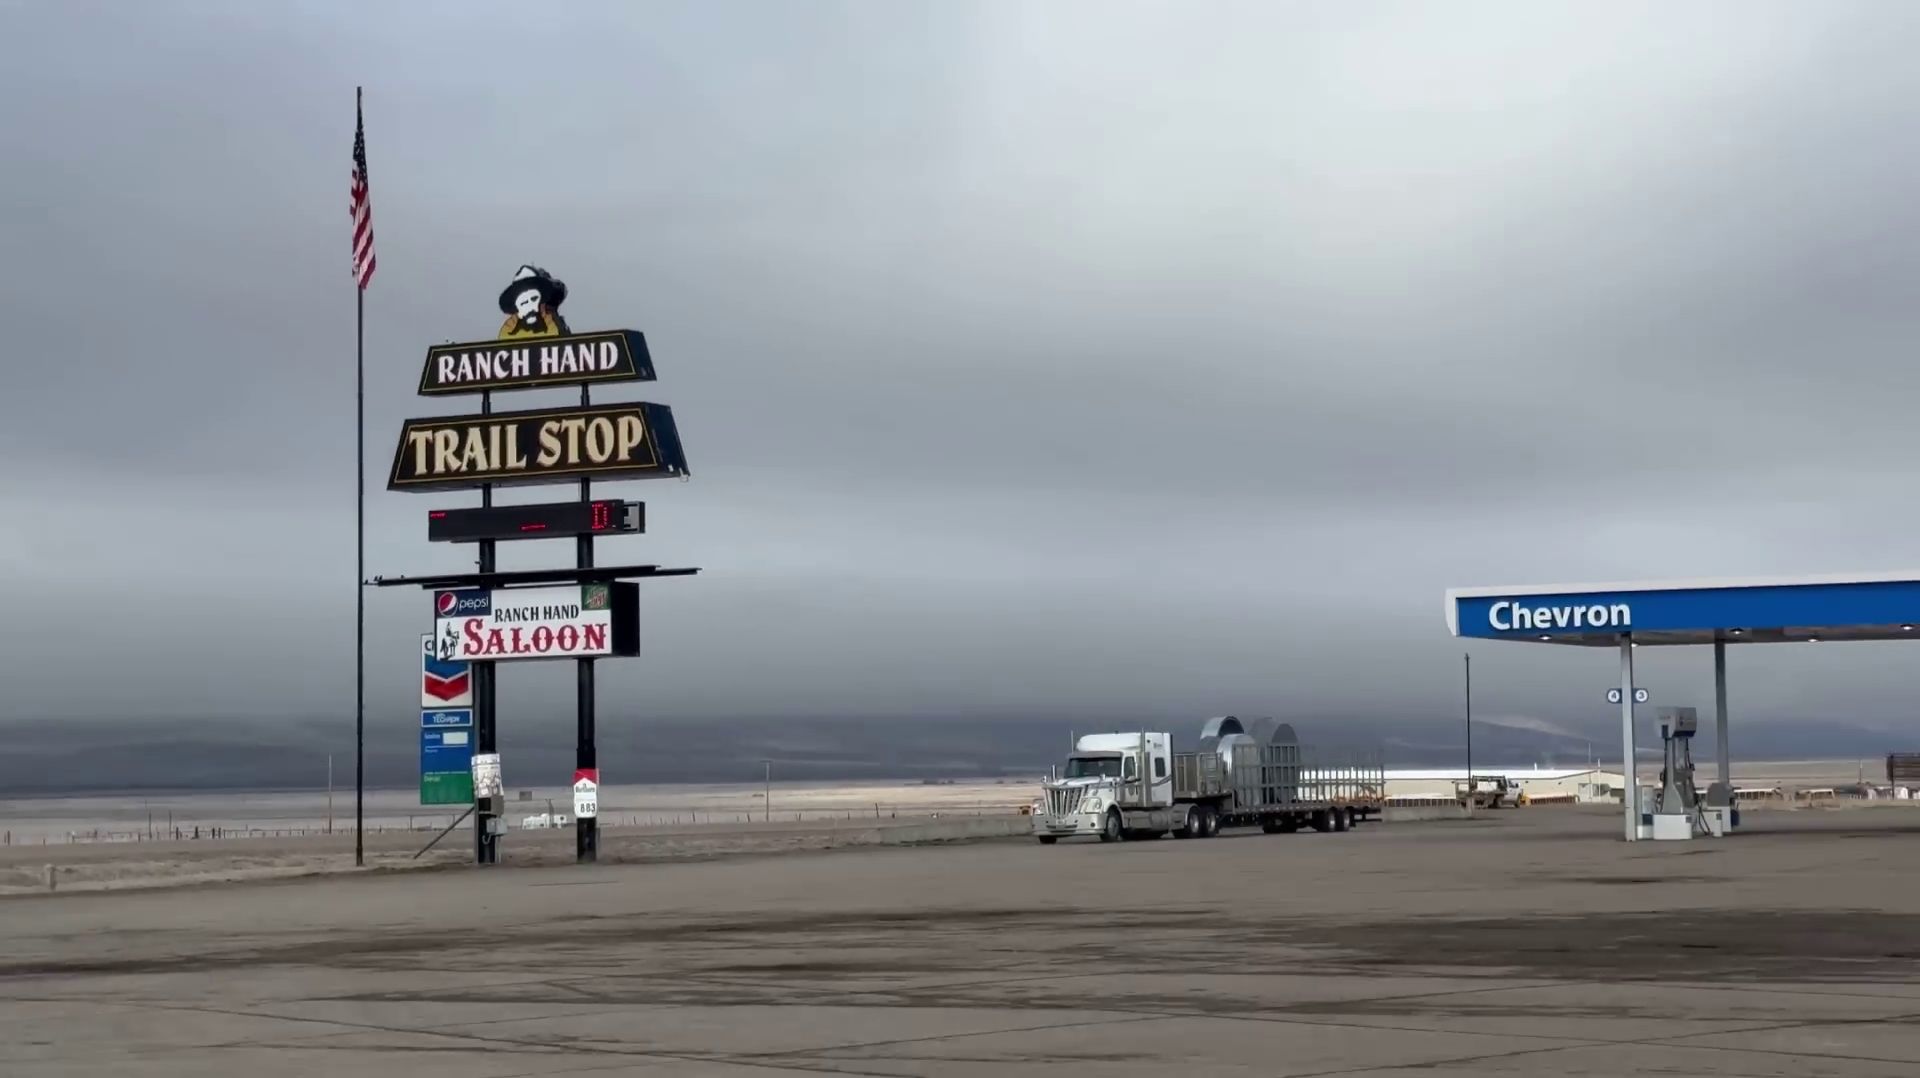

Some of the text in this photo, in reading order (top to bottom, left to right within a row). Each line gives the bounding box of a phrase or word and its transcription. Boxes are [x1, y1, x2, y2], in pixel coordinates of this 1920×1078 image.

[438, 342, 619, 383] RANCH HAND
[409, 415, 643, 476] TRAIL STOP
[459, 596, 489, 611] pepsi
[494, 605, 579, 623] RANCH HAND
[1489, 601, 1632, 630] Chevron
